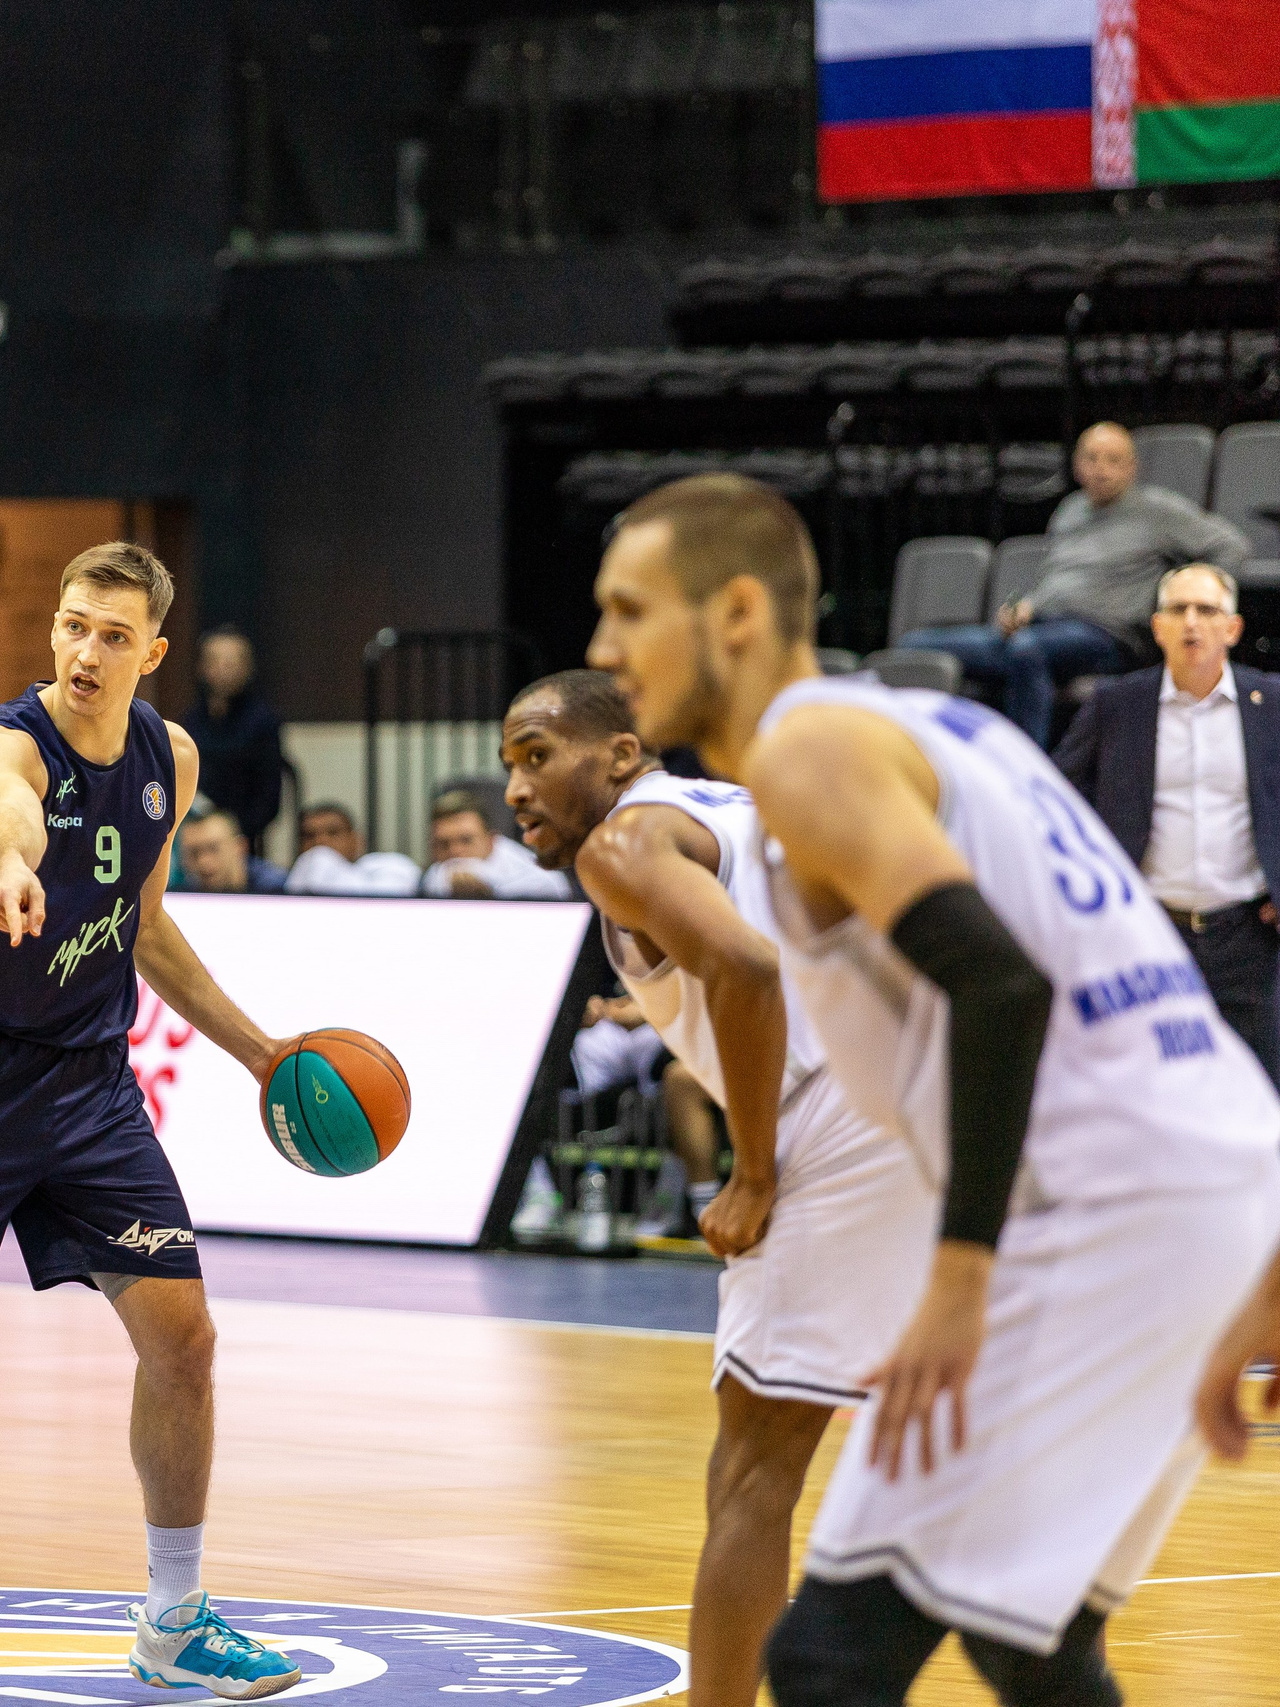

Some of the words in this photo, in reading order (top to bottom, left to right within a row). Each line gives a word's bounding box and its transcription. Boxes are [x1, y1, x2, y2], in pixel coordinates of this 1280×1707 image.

[94, 826, 121, 883] 9
[318, 1624, 577, 1662] ЛИГА
[438, 1666, 588, 1695] ВТБ
